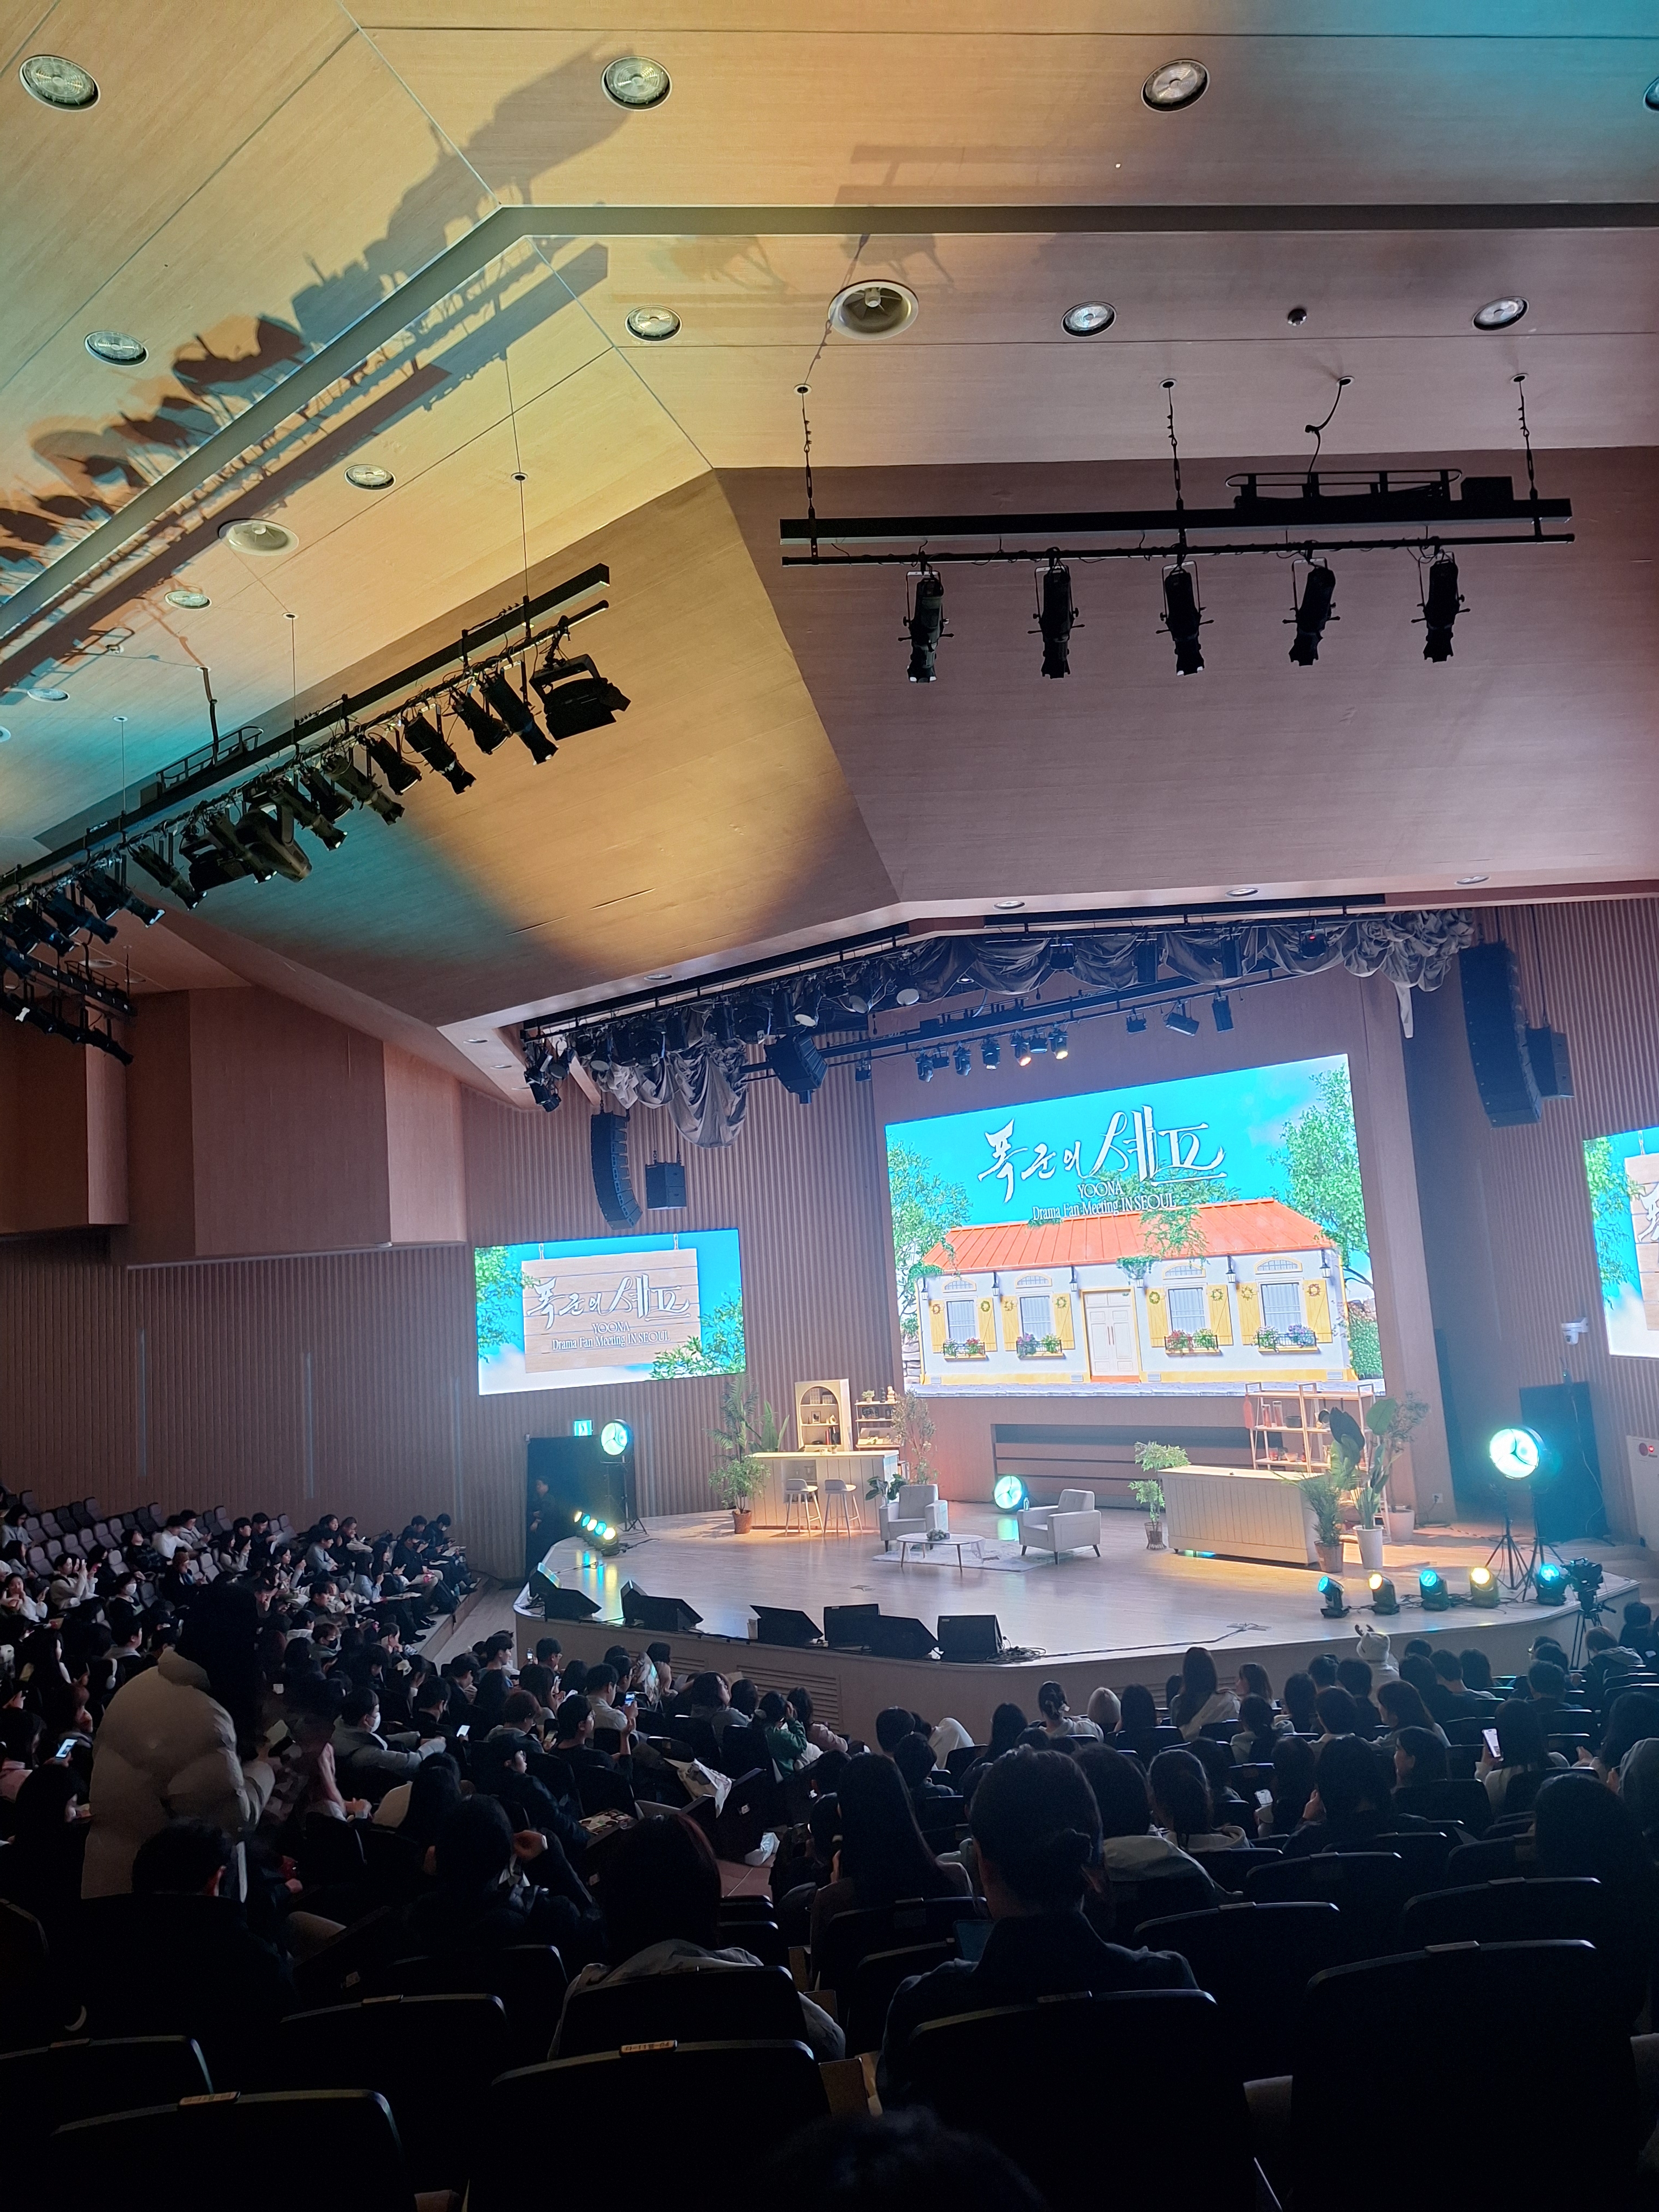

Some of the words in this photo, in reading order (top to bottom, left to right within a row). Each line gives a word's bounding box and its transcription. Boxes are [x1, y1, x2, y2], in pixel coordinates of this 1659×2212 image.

[978, 1117, 1084, 1204] 폭군의
[1086, 1105, 1227, 1187] 셰프
[1077, 1180, 1124, 1199] YOONA
[1032, 1206, 1061, 1220] Drama
[1063, 1203, 1080, 1217] Fan
[1082, 1199, 1118, 1216] Meeting
[1121, 1198, 1133, 1212] IN
[1134, 1193, 1176, 1211] SEOUL
[527, 1277, 603, 1330] 폭군의
[605, 1274, 691, 1321] 셰프
[592, 1321, 630, 1334] YOONA
[552, 1339, 577, 1351] Drama
[579, 1336, 593, 1348] Fan
[595, 1335, 626, 1347] Meeting
[628, 1333, 636, 1344] IN
[638, 1330, 670, 1344] SEOUL
